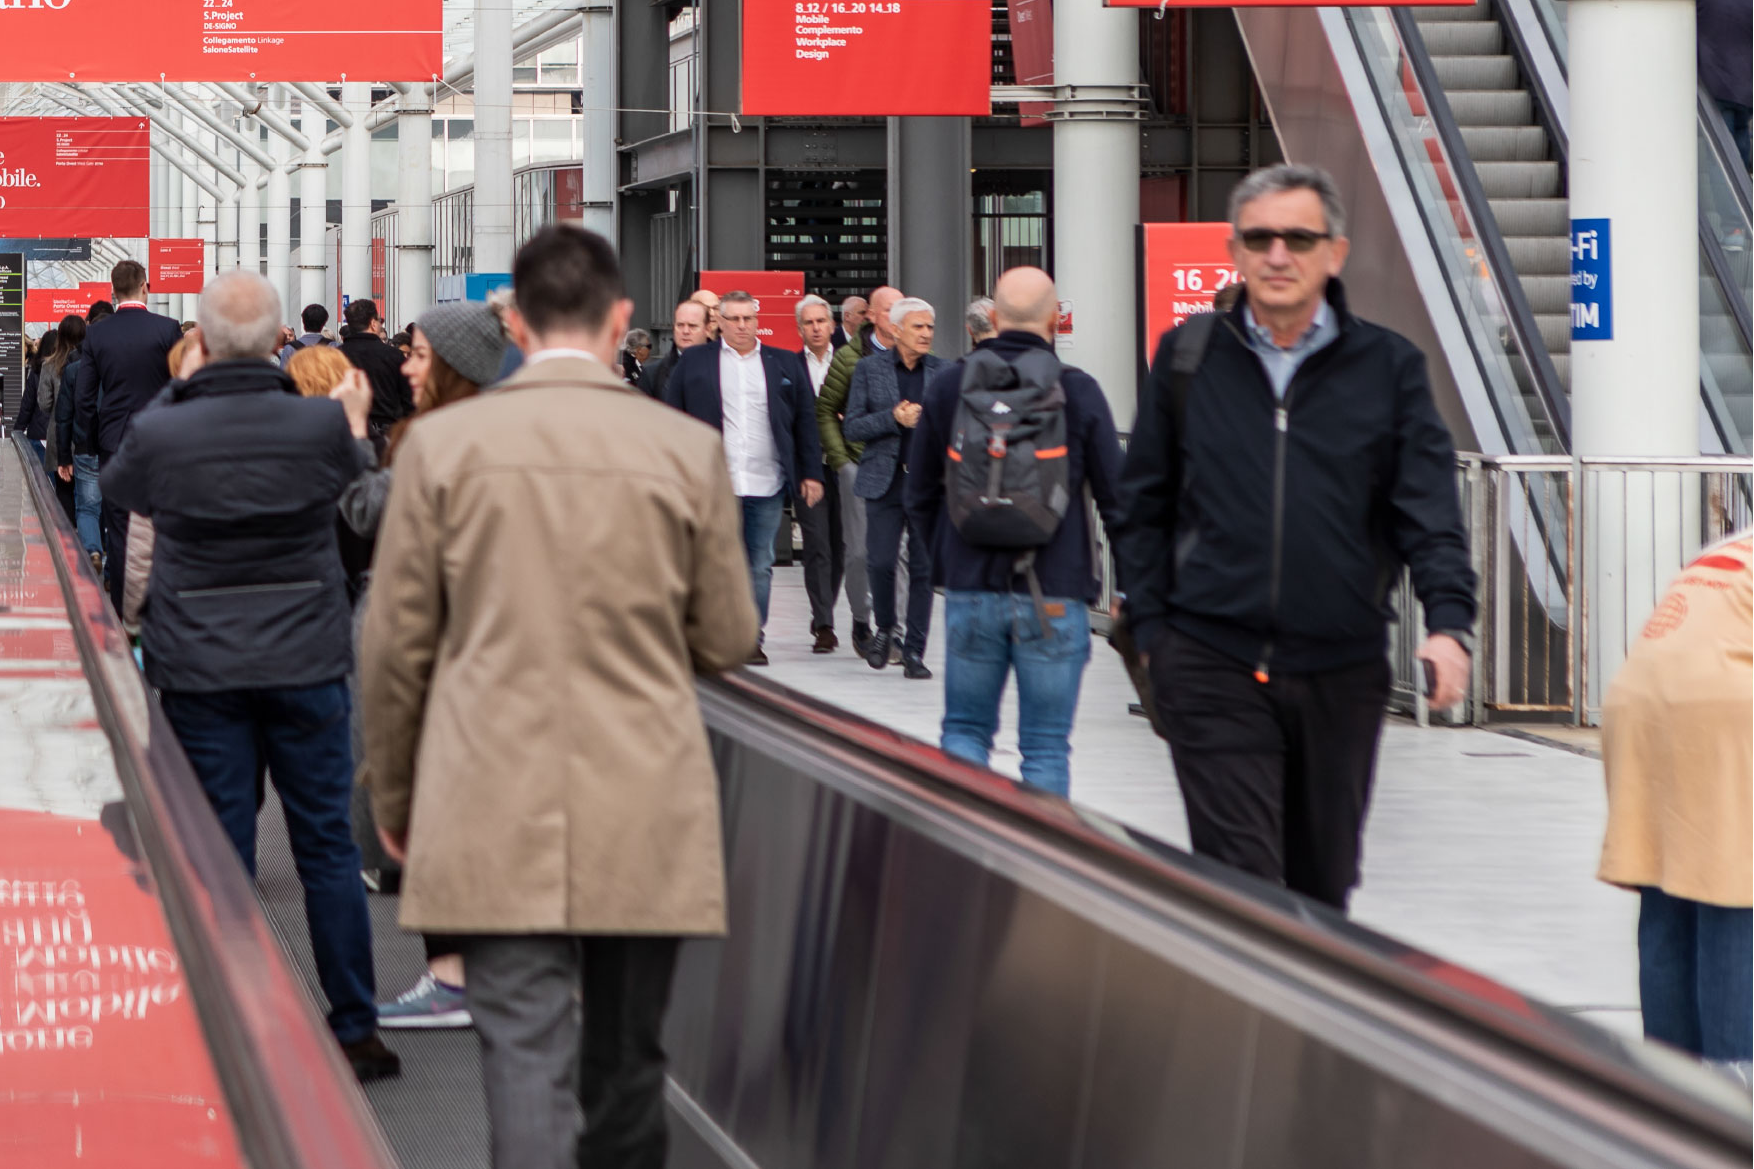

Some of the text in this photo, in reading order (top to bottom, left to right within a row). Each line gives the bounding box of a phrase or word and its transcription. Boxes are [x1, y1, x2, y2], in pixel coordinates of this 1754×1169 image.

[204, 0, 232, 7] 22_24
[796, 3, 900, 13] 8_12 / 16_20 14_18
[204, 11, 243, 21] S.Project
[796, 15, 829, 26] Mobile
[796, 25, 863, 36] Complemento
[203, 37, 284, 45] Collegamento Linkage
[796, 37, 846, 48] Workplace
[203, 44, 258, 53] SaloneSatellite
[796, 47, 829, 60] Design
[1583, 270, 1598, 290] by
[1172, 301, 1217, 314] Mobil
